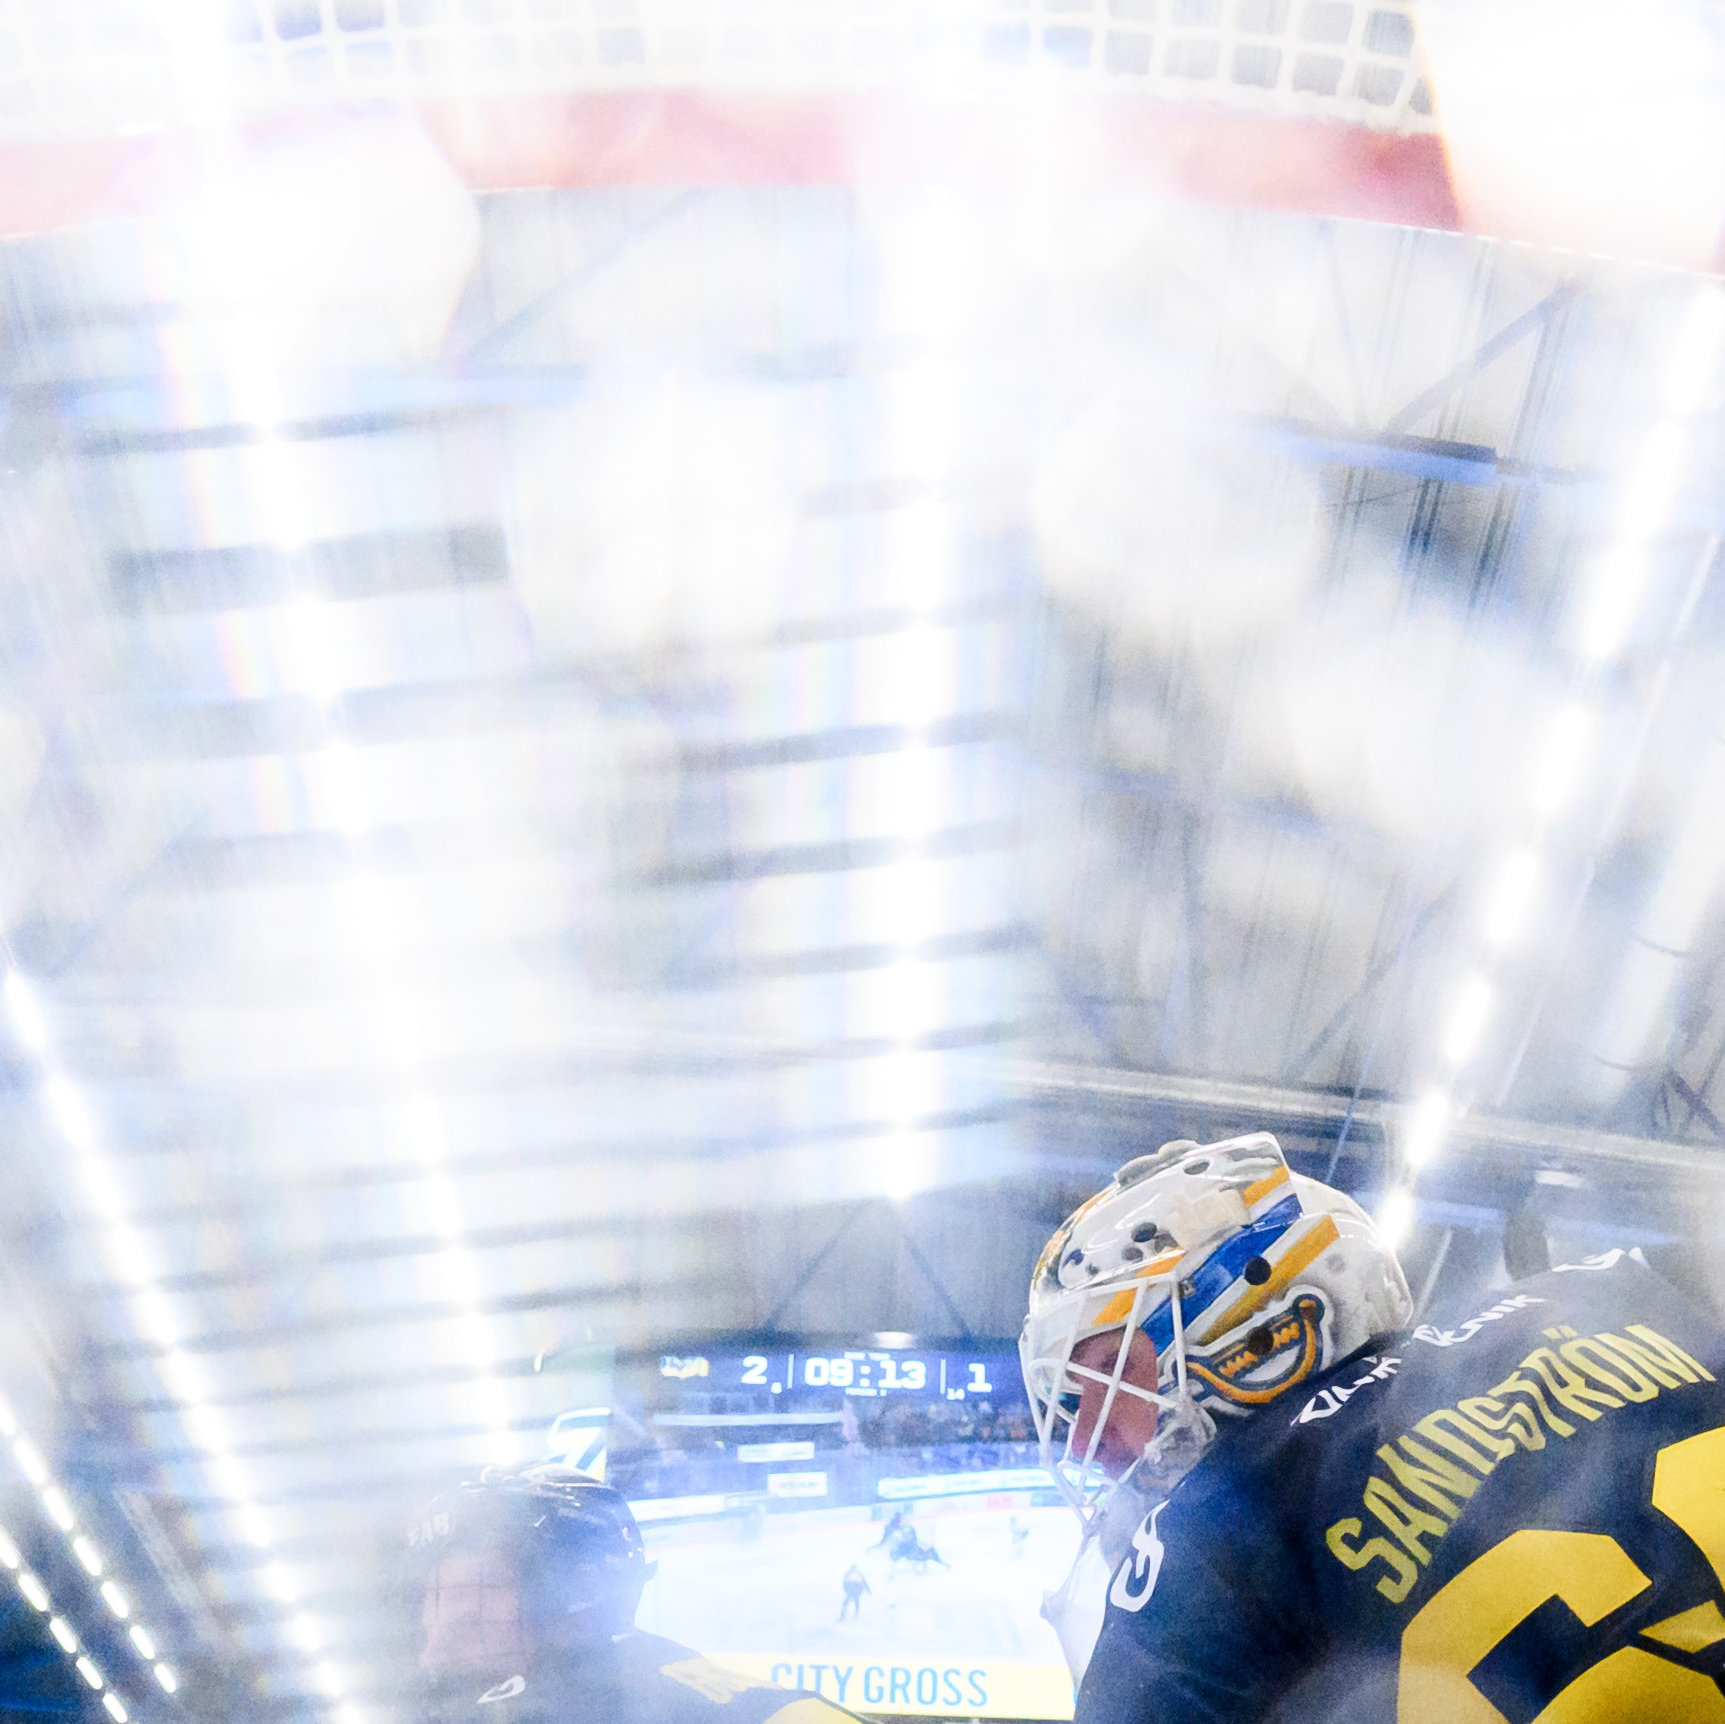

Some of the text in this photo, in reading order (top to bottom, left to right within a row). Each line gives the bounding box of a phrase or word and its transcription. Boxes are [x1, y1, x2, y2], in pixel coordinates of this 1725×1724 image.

[740, 1355, 769, 1385] 2
[804, 1356, 927, 1390] 09:13
[966, 1362, 993, 1393] 1
[1325, 1324, 1717, 1604] SANDSTRÖM
[771, 1662, 854, 1704] CITY
[863, 1666, 988, 1708] GROSS
